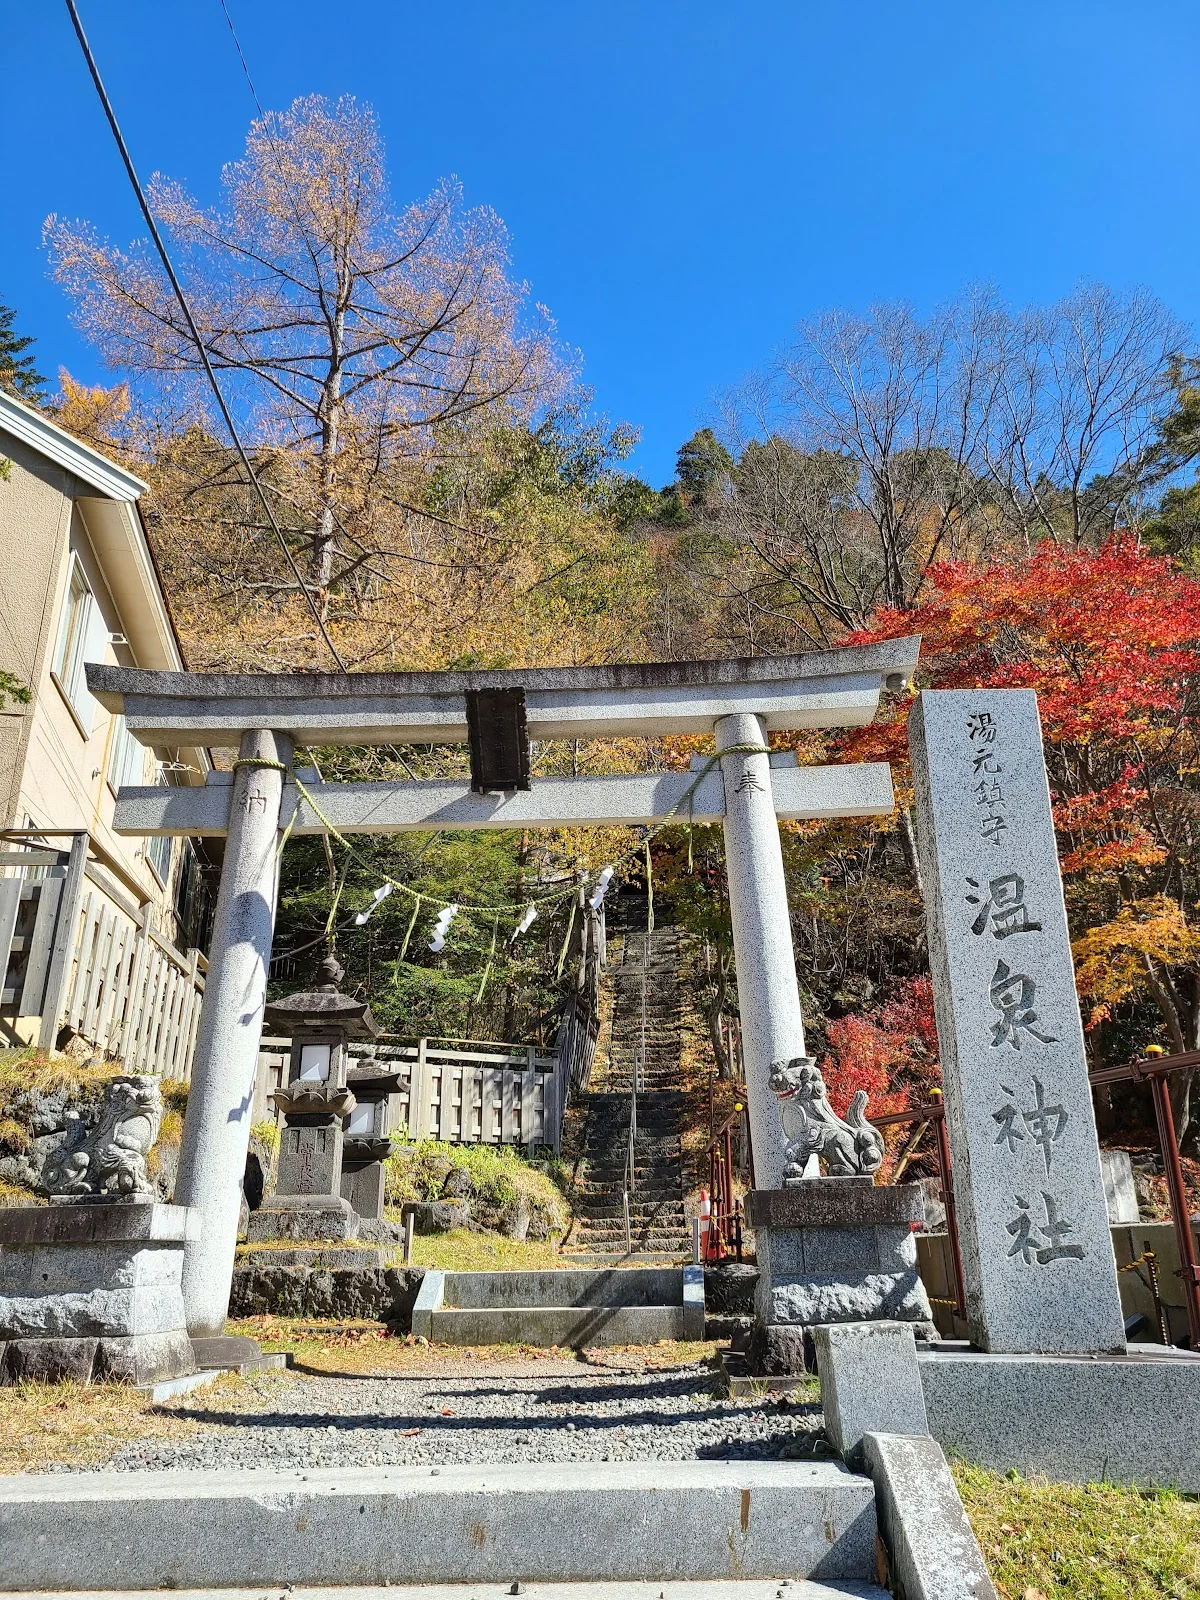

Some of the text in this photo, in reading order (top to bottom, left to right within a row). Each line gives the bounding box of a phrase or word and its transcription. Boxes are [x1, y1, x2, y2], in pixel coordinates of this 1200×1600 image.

[239, 788, 267, 814] 納
[735, 770, 766, 800] 奉
[966, 712, 1008, 846] 湯元鎮守
[964, 872, 1084, 1265] 温泉神社
